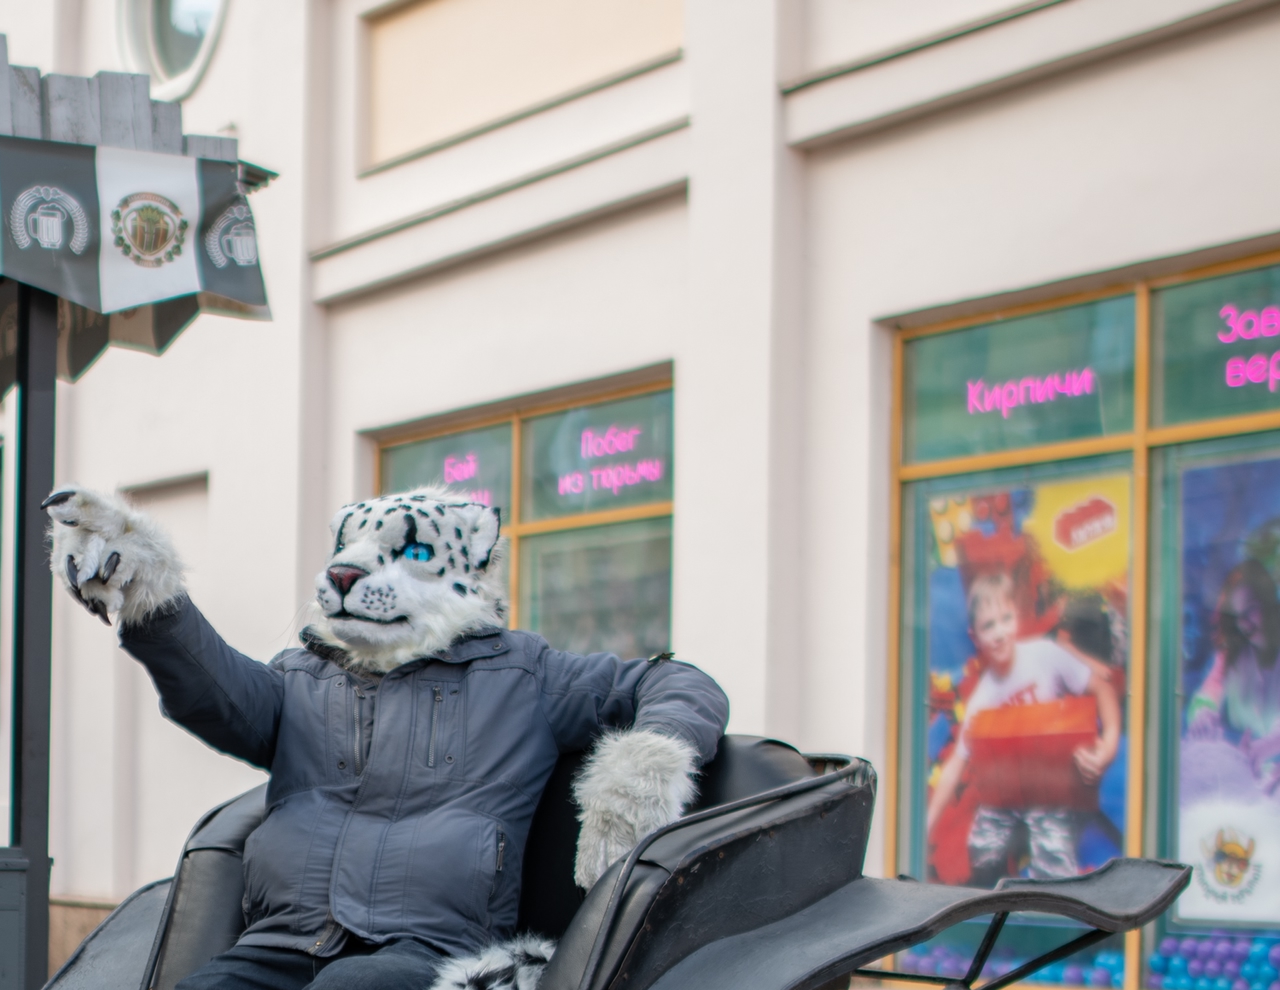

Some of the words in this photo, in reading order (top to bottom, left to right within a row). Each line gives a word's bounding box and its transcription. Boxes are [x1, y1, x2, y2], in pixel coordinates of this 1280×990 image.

[967, 367, 1093, 419] Кирпичи
[581, 425, 641, 459] Побег
[557, 471, 584, 495] из
[589, 458, 662, 496] тюрьмы
